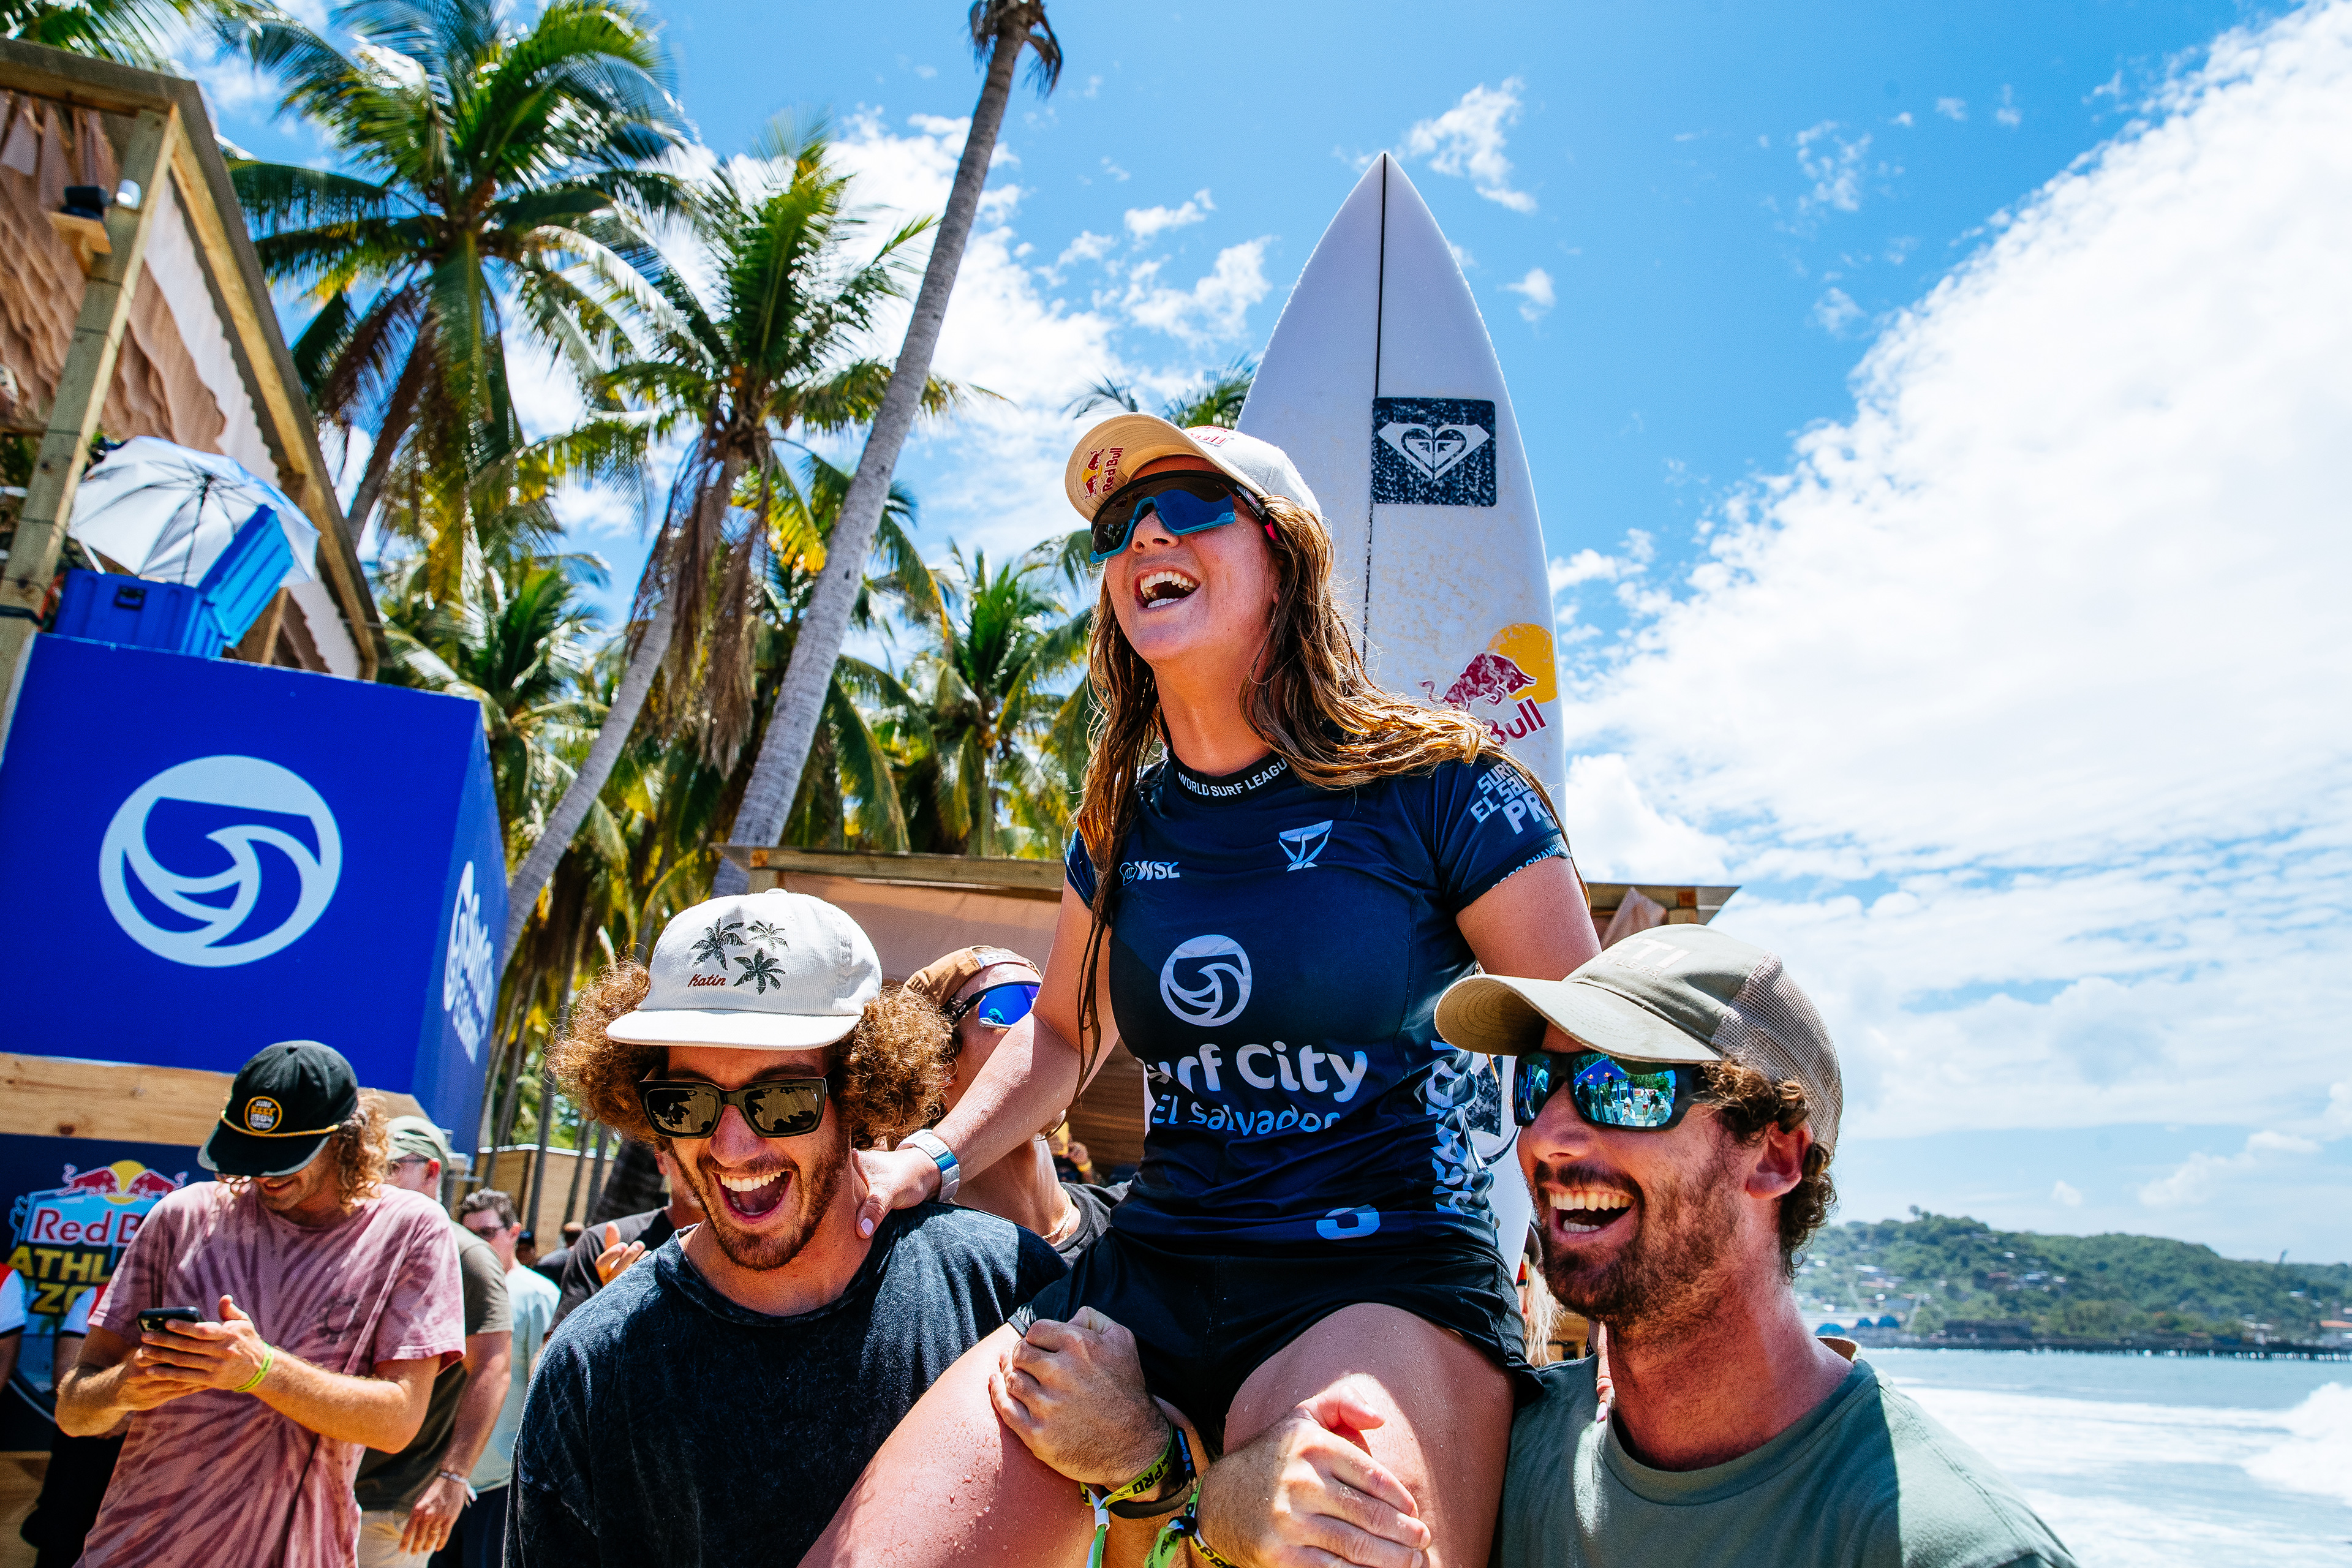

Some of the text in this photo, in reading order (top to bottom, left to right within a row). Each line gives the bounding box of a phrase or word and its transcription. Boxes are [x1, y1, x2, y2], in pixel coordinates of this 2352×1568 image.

[1101, 447, 1125, 493] Red Bull
[1178, 757, 1287, 797] WORLD SURF LEAGU
[1471, 796, 1501, 823] EL
[1502, 790, 1551, 835] PR
[1135, 861, 1180, 881] WSL
[687, 973, 726, 987] Katin
[1236, 1041, 1368, 1102] City
[1152, 1094, 1341, 1136] El Salvador
[32, 1208, 113, 1242] Red
[7, 1245, 112, 1283] ATHL
